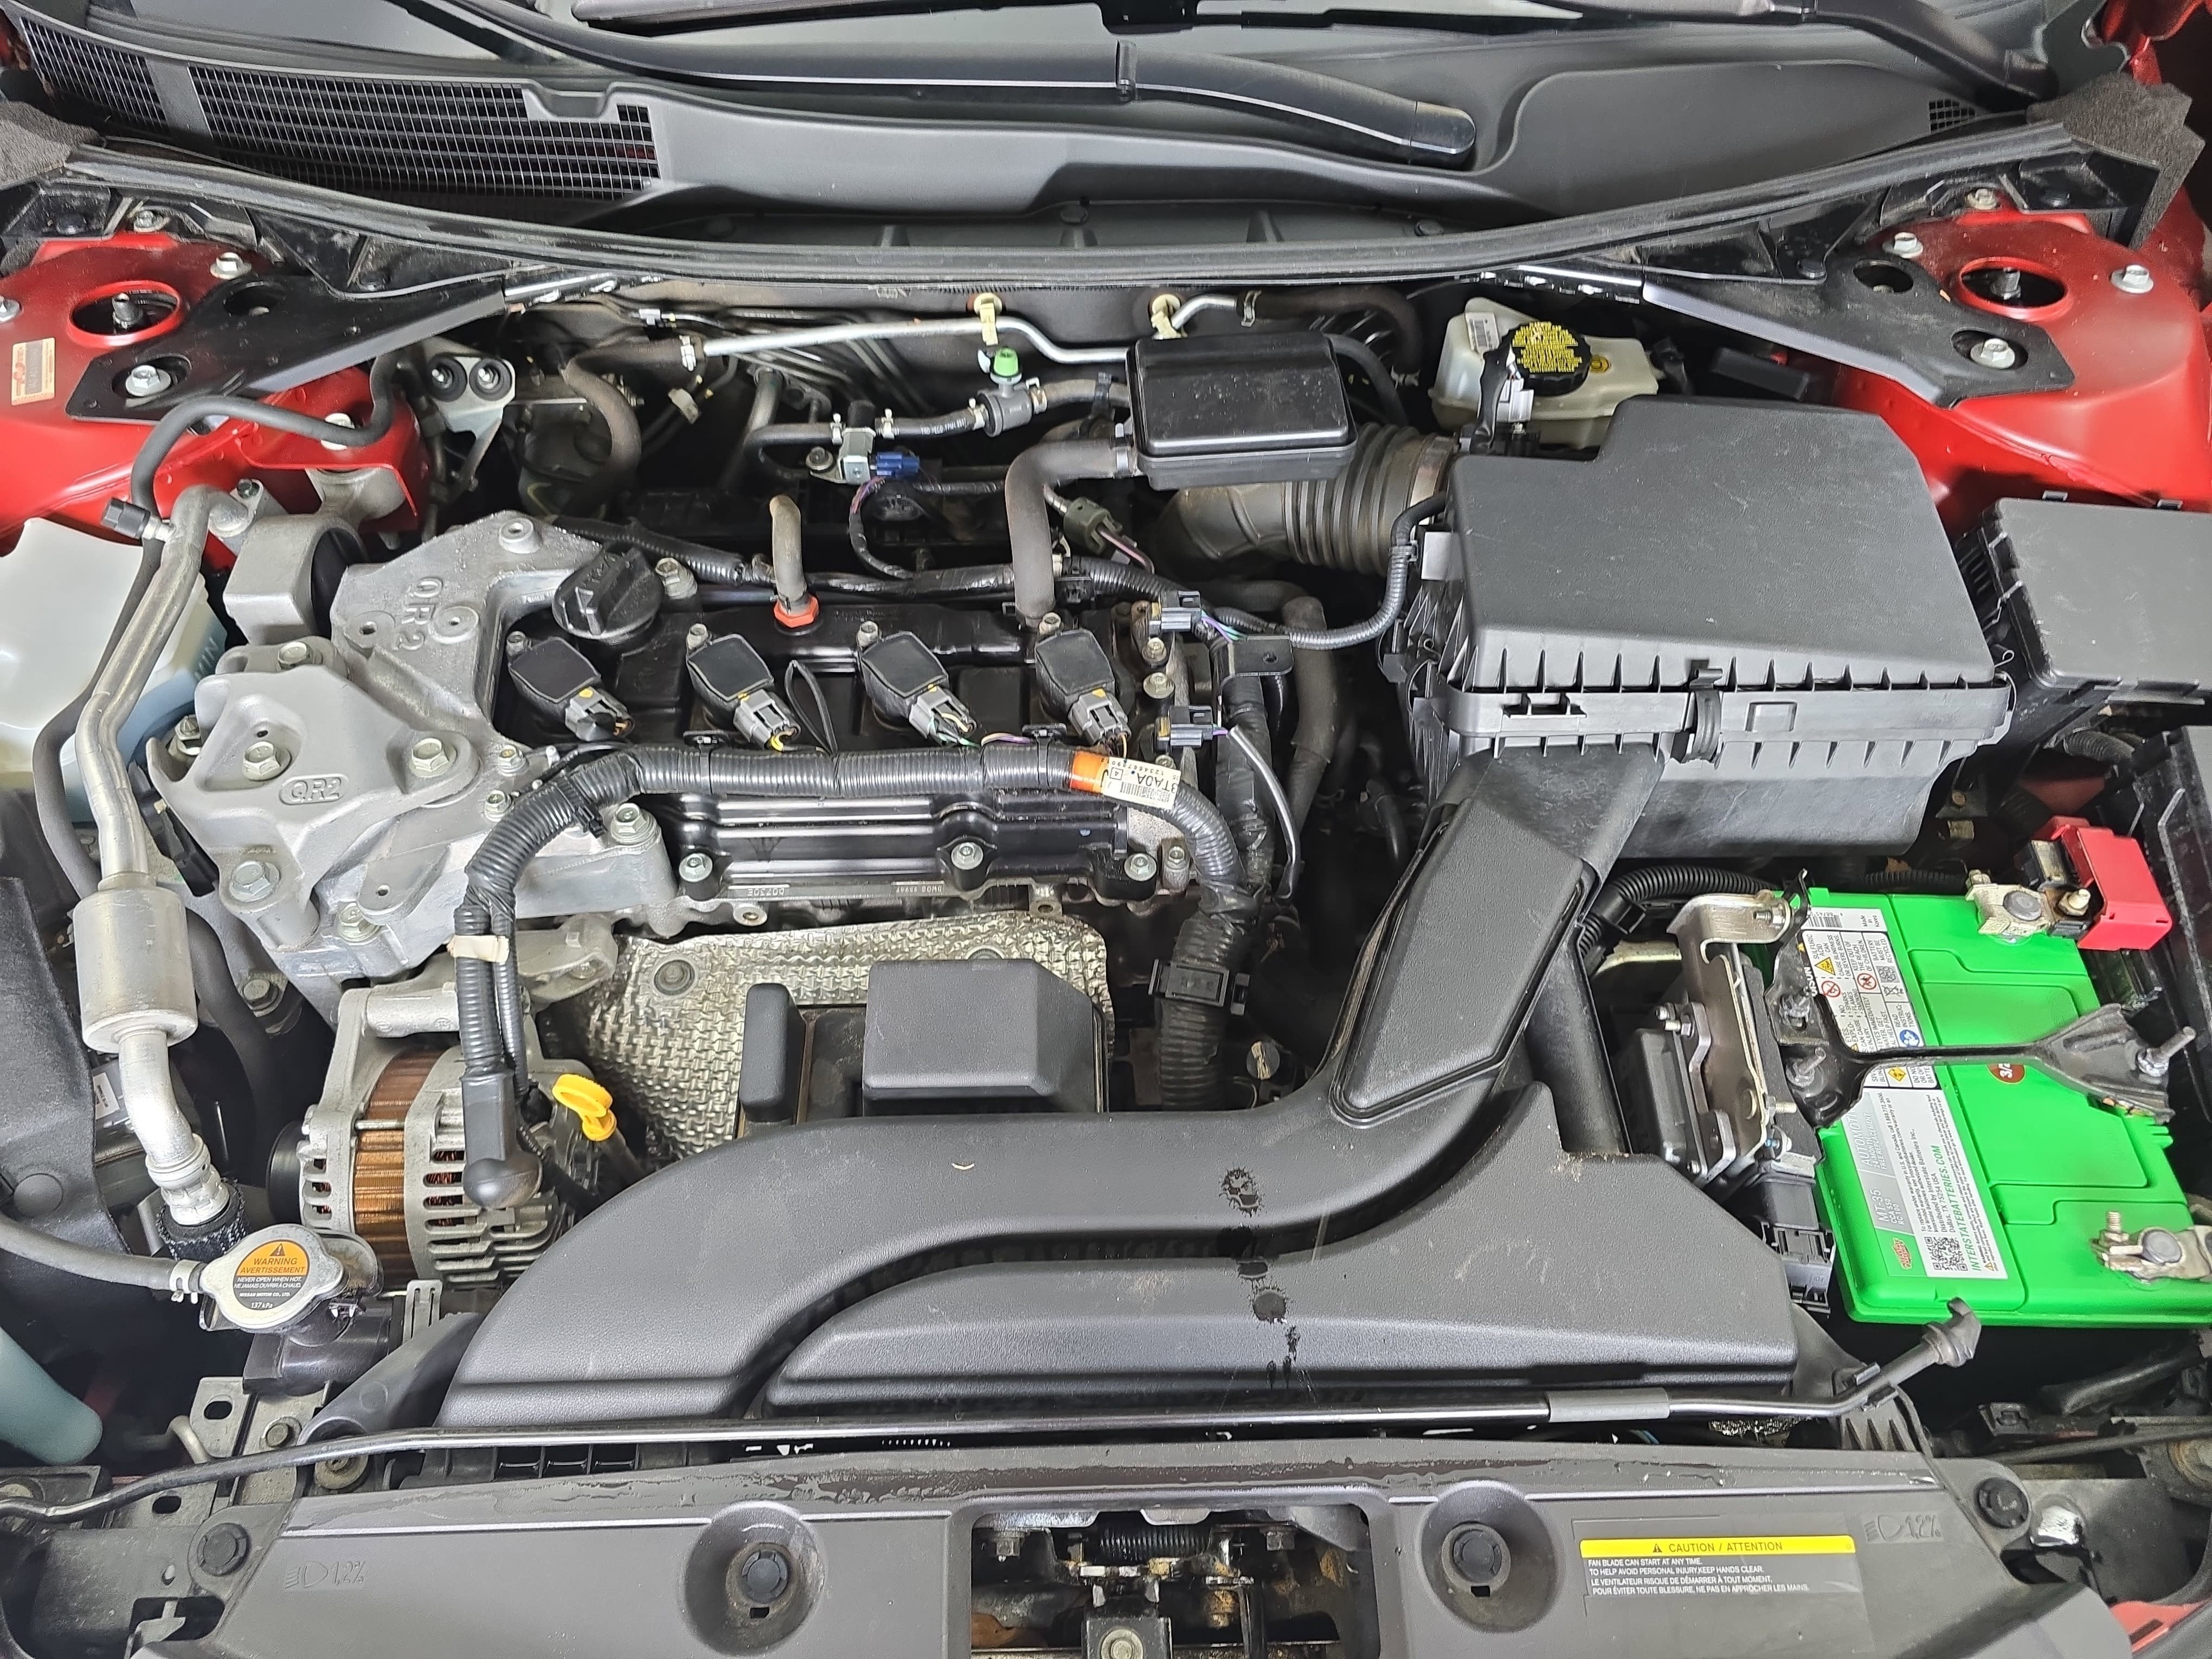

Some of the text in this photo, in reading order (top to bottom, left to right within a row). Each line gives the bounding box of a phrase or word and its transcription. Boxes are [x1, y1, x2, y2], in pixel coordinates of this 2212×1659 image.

[290, 779, 342, 800] QR2
[1806, 934, 1819, 959] SULFURIC
[1815, 943, 1825, 956] ACID
[1822, 943, 1831, 952] CAN
[1826, 934, 1844, 975] CAUSE BLINDNESS
[1846, 948, 1855, 957] OUT
[1851, 943, 1862, 960] REACH
[1867, 940, 1879, 960] BATTERY
[1876, 948, 1885, 960] MUST
[1838, 951, 1849, 968] SEVERE
[1850, 959, 1859, 970] KEEP
[1840, 992, 1851, 1011] SPARKS
[1847, 991, 1858, 1010] FLAMES
[1851, 988, 1863, 1010] SMOKING
[1838, 1005, 1846, 1013] NO
[1862, 996, 1877, 1030] IMMEDIATELY
[1854, 1019, 1863, 1035] CAUSE
[1885, 1024, 1893, 1037] HELP
[1863, 1113, 1887, 1169] FREE REPLACEMENT
[1911, 1141, 1925, 1165] Batteries
[1904, 1175, 1915, 1194] warranty
[1913, 1166, 1924, 1189] authorized
[1920, 1166, 1934, 1192] Interstate
[1930, 1172, 1939, 1185] USA
[1910, 1195, 1918, 1207] under
[1921, 1190, 1931, 1209] Batteries
[1934, 1186, 1945, 1203] 75254
[1869, 1189, 1889, 1221] MT-35
[1884, 1198, 1898, 1223] CCA 550
[1892, 1204, 1905, 1224] RC 100
[1931, 1145, 1981, 1270] INTERSTATEBATTERIES.COM
[1914, 1208, 1926, 1225] replace
[1920, 1208, 1930, 1223] limited
[1927, 1211, 1938, 1232] Interstate
[1932, 1202, 1947, 1232] Distributed
[1944, 1213, 1956, 1232] Dallas,
[1669, 1542, 1714, 1552] CAUTION
[1727, 1541, 1783, 1551] ATTENTION
[1644, 1577, 1669, 1585] RISQUE
[1680, 1575, 1716, 1584] DÉMARRER
[1718, 1574, 1723, 1584] À
[1593, 1587, 1612, 1596] POUR
[1613, 1586, 1635, 1595] ÉVITER
[1696, 1585, 1705, 1593] NE
[1732, 1584, 1772, 1592] APPROCHER
[1773, 1584, 1786, 1592] LES
